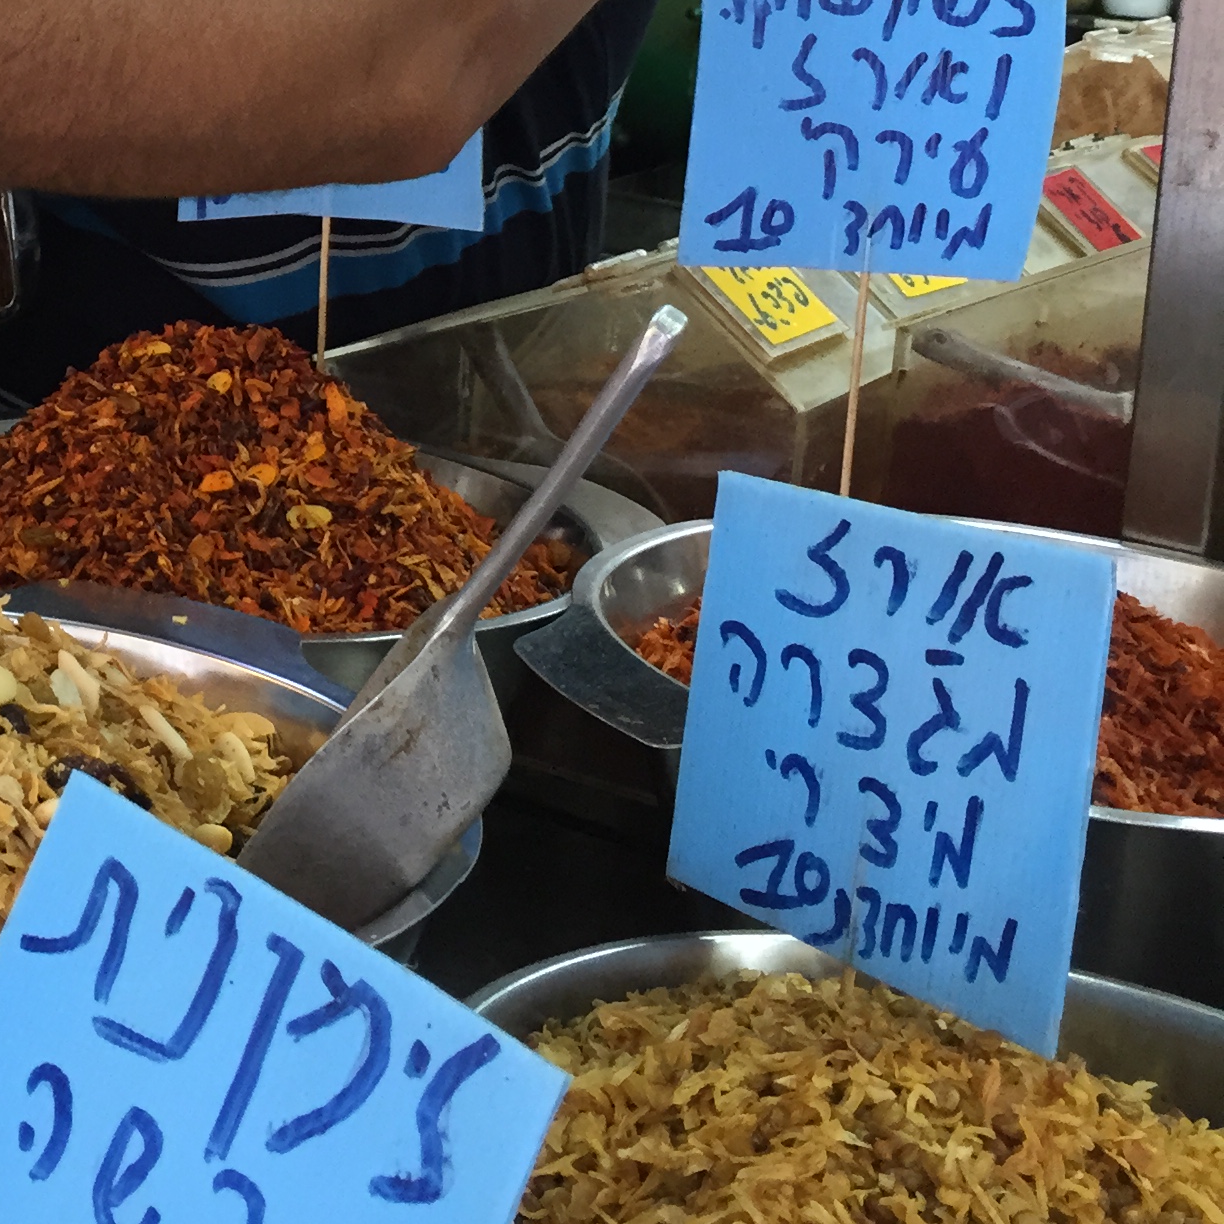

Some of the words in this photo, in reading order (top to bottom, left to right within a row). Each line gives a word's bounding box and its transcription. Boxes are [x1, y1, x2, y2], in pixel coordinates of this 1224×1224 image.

[777, 32, 1013, 121] ואורז
[704, 185, 795, 253] 10
[841, 200, 993, 261] מיוחד
[775, 517, 1034, 649] אורז
[734, 838, 831, 910] 10
